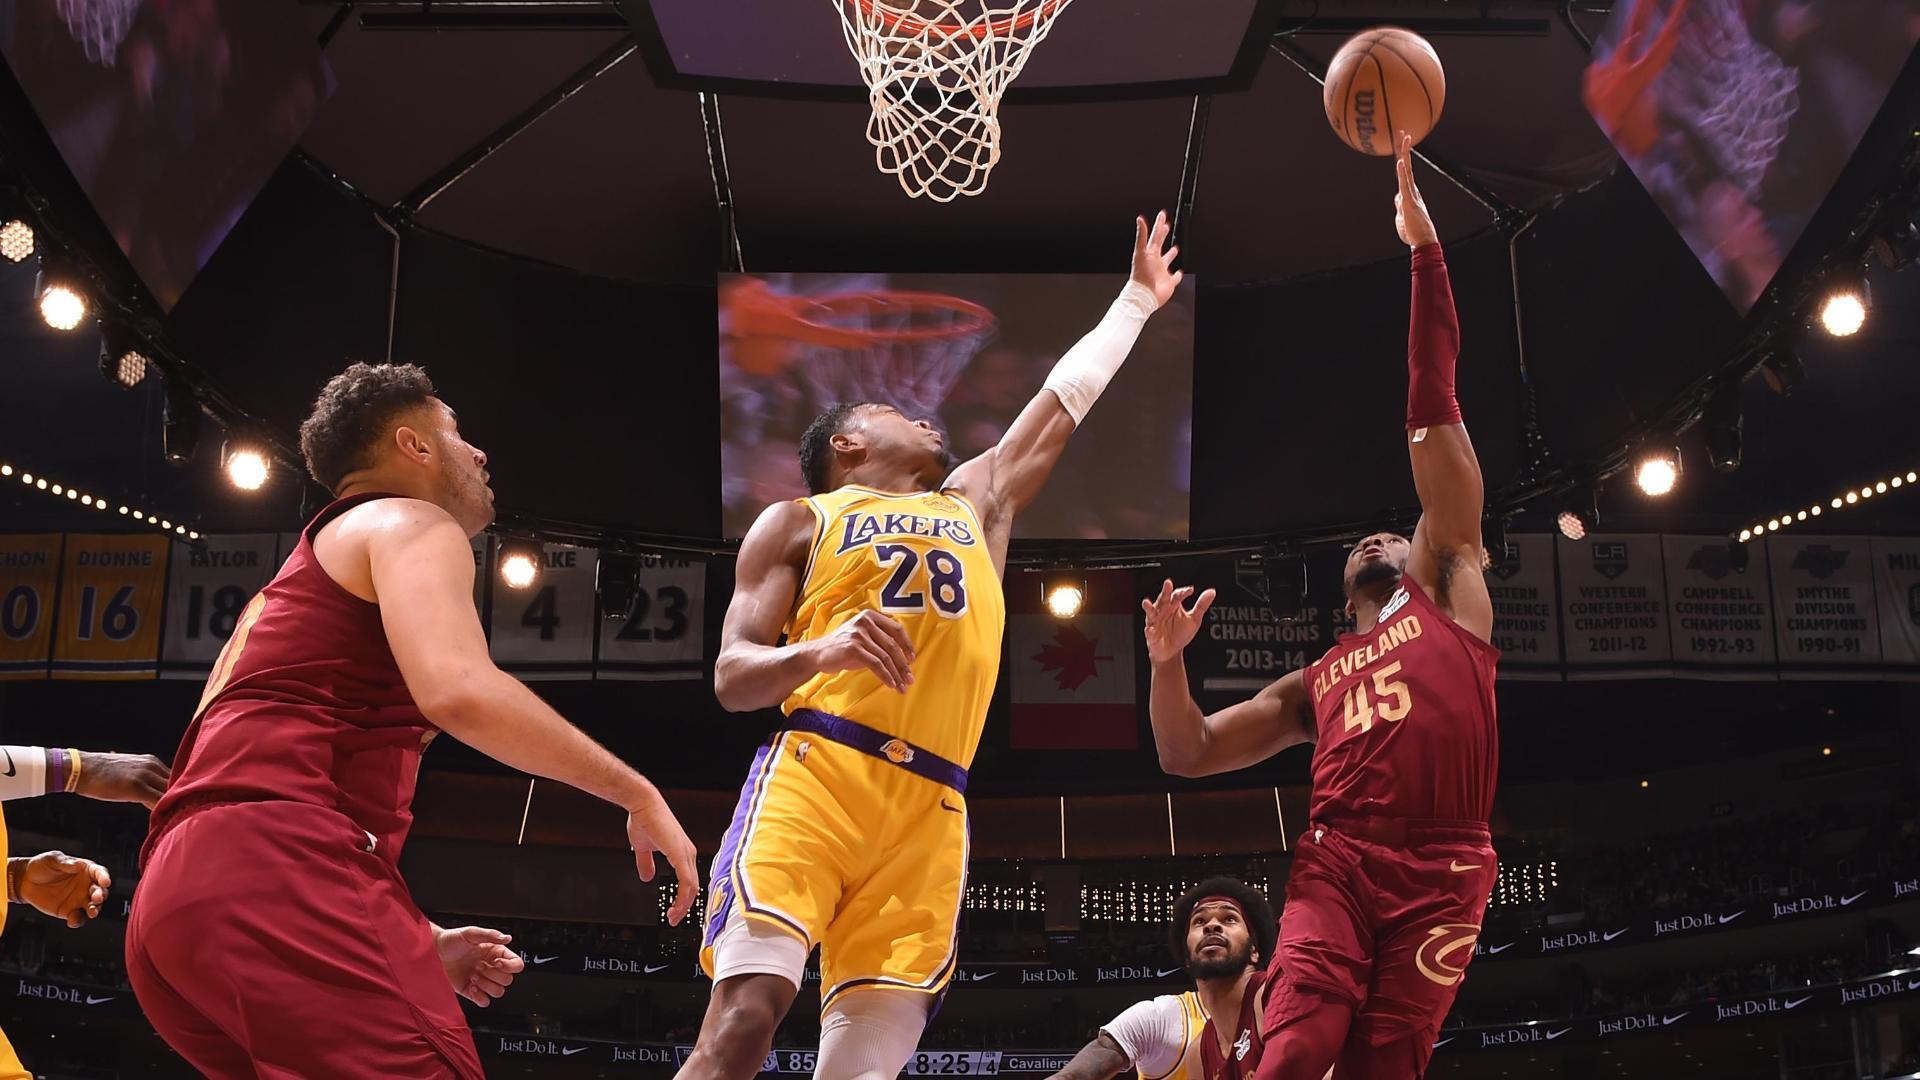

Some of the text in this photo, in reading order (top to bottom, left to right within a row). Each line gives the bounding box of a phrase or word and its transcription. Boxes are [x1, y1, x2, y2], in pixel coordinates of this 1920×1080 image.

[836, 512, 975, 556] LAKERS
[0, 551, 47, 567] HON
[78, 551, 152, 567] DIONNE
[188, 551, 258, 568] TAYLOR
[543, 551, 577, 568] AKE
[873, 543, 969, 620] 28
[1579, 587, 1646, 598] WESTERN
[1682, 587, 1755, 600] CAMPBELL
[1797, 587, 1850, 599] SMYTHE
[76, 585, 139, 641] 16
[186, 585, 248, 640] 18
[521, 585, 561, 642] 4
[615, 586, 688, 643] 23
[1209, 607, 1270, 622] STANLE
[1569, 602, 1660, 615] CONFERENCE
[1675, 602, 1765, 616] CONFERENCE
[1795, 602, 1856, 615] DIVISION
[1495, 619, 1546, 632] MPIONS
[1575, 618, 1657, 631] CHAMPIONS
[1681, 618, 1762, 632] CHAMPIONS
[1787, 618, 1868, 632] CHAMPIONS
[1209, 624, 1320, 642] CHAMPIONS
[1589, 637, 1647, 652] 2011-12
[1691, 638, 1755, 653] 1992-93
[1797, 638, 1861, 653] 1990-91
[1225, 648, 1307, 670] 2013-14
[1315, 615, 1424, 703] CLEVELAND
[1343, 661, 1412, 734] 45
[1894, 880, 1919, 898] Just
[1773, 895, 1837, 919] Just Do It.
[1655, 914, 1716, 936] Just Do It.
[1541, 931, 1600, 953] Just Do It.
[583, 957, 641, 973] Just Do It.
[803, 966, 820, 981] Jus
[959, 970, 969, 982] It.
[1021, 969, 1079, 984] Just Do It.
[1096, 967, 1153, 983] Just Do It.
[16, 980, 82, 1003] Just Do It.
[1841, 979, 1905, 1005] Just Do It.
[1716, 998, 1781, 1022] Just Do It.
[1598, 1014, 1660, 1037] Just Do It.
[498, 1038, 559, 1055] Just Do It.
[1481, 1029, 1543, 1048] Just Do It.
[612, 1047, 637, 1062] Just
[639, 1049, 658, 1062] Do
[661, 1050, 672, 1063] It.
[789, 1053, 815, 1071] 85
[915, 1054, 970, 1074] 8:25
[986, 1059, 996, 1074] 4
[1009, 1058, 1068, 1069] Cavaliers
